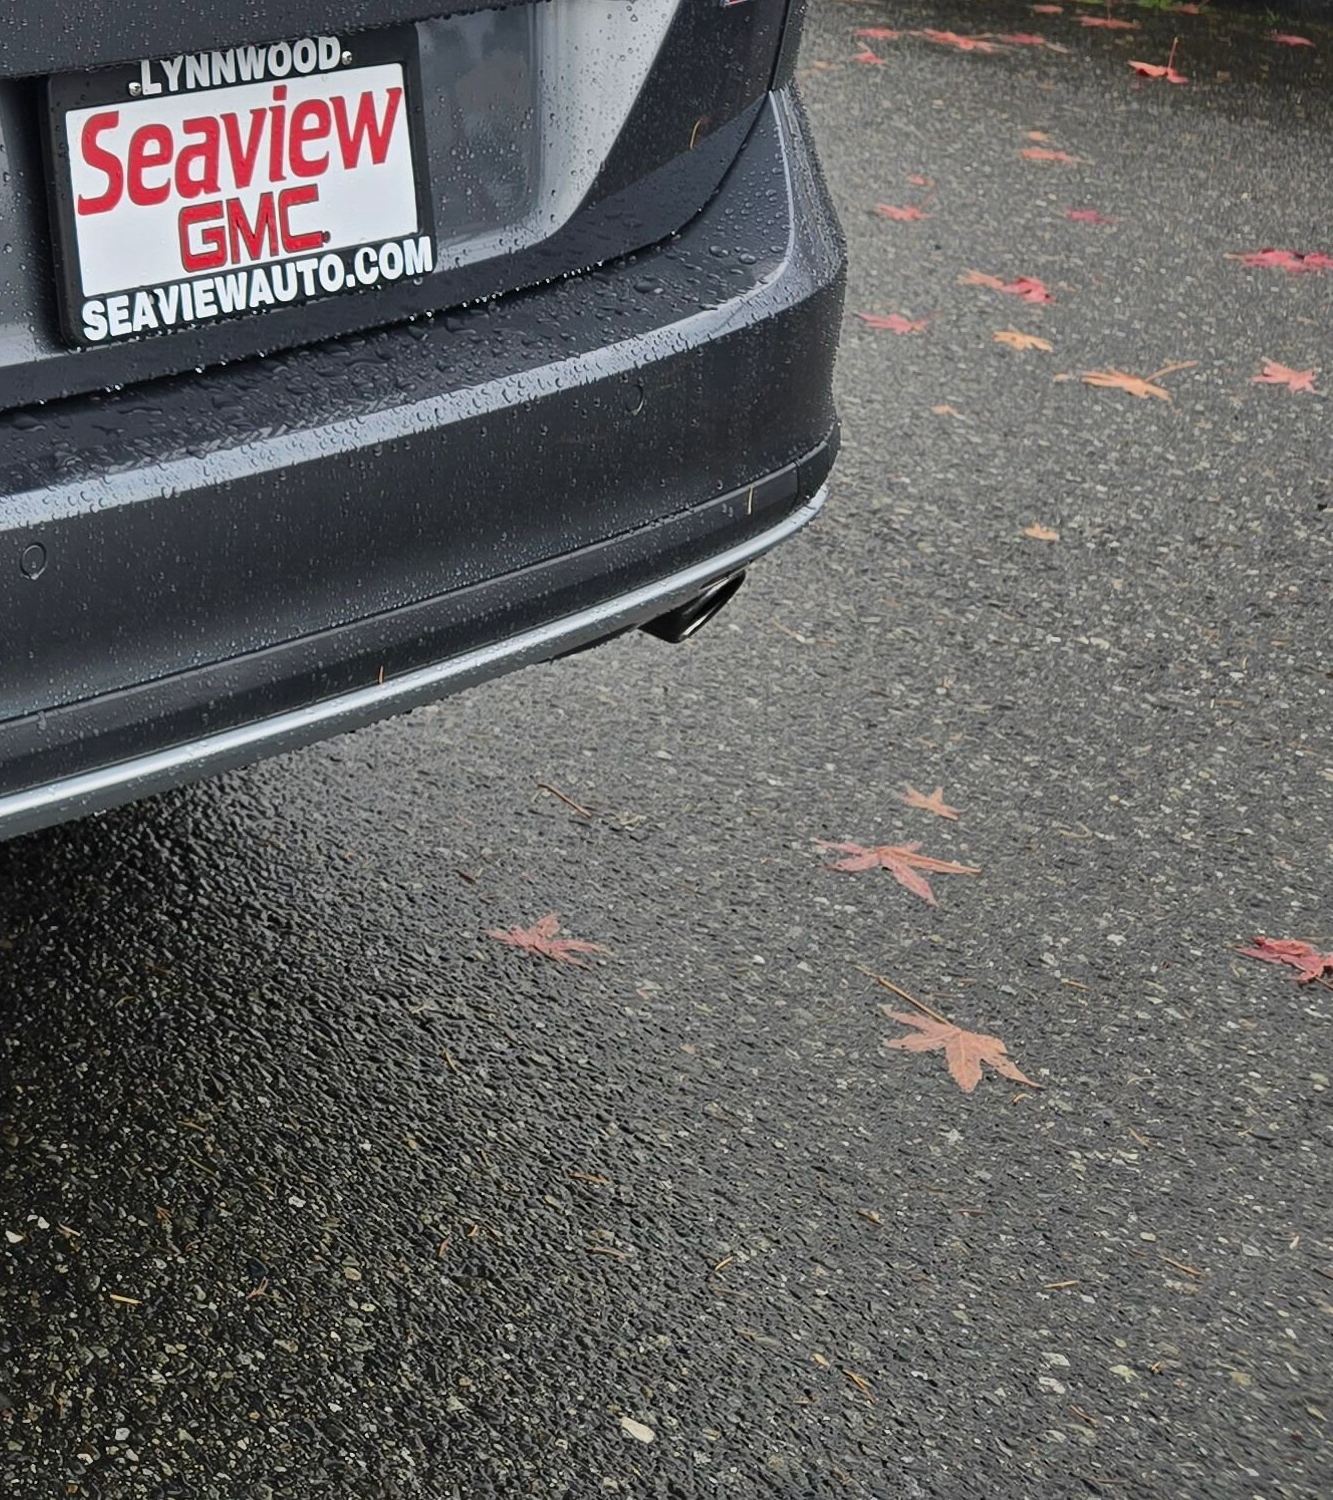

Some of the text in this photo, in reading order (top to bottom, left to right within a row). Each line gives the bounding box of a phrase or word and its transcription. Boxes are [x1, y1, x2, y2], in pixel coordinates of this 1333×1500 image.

[142, 36, 340, 95] LYNNWOOD
[77, 85, 403, 216] Seaview
[83, 236, 433, 341] SEAVIEWAUTO.COM
